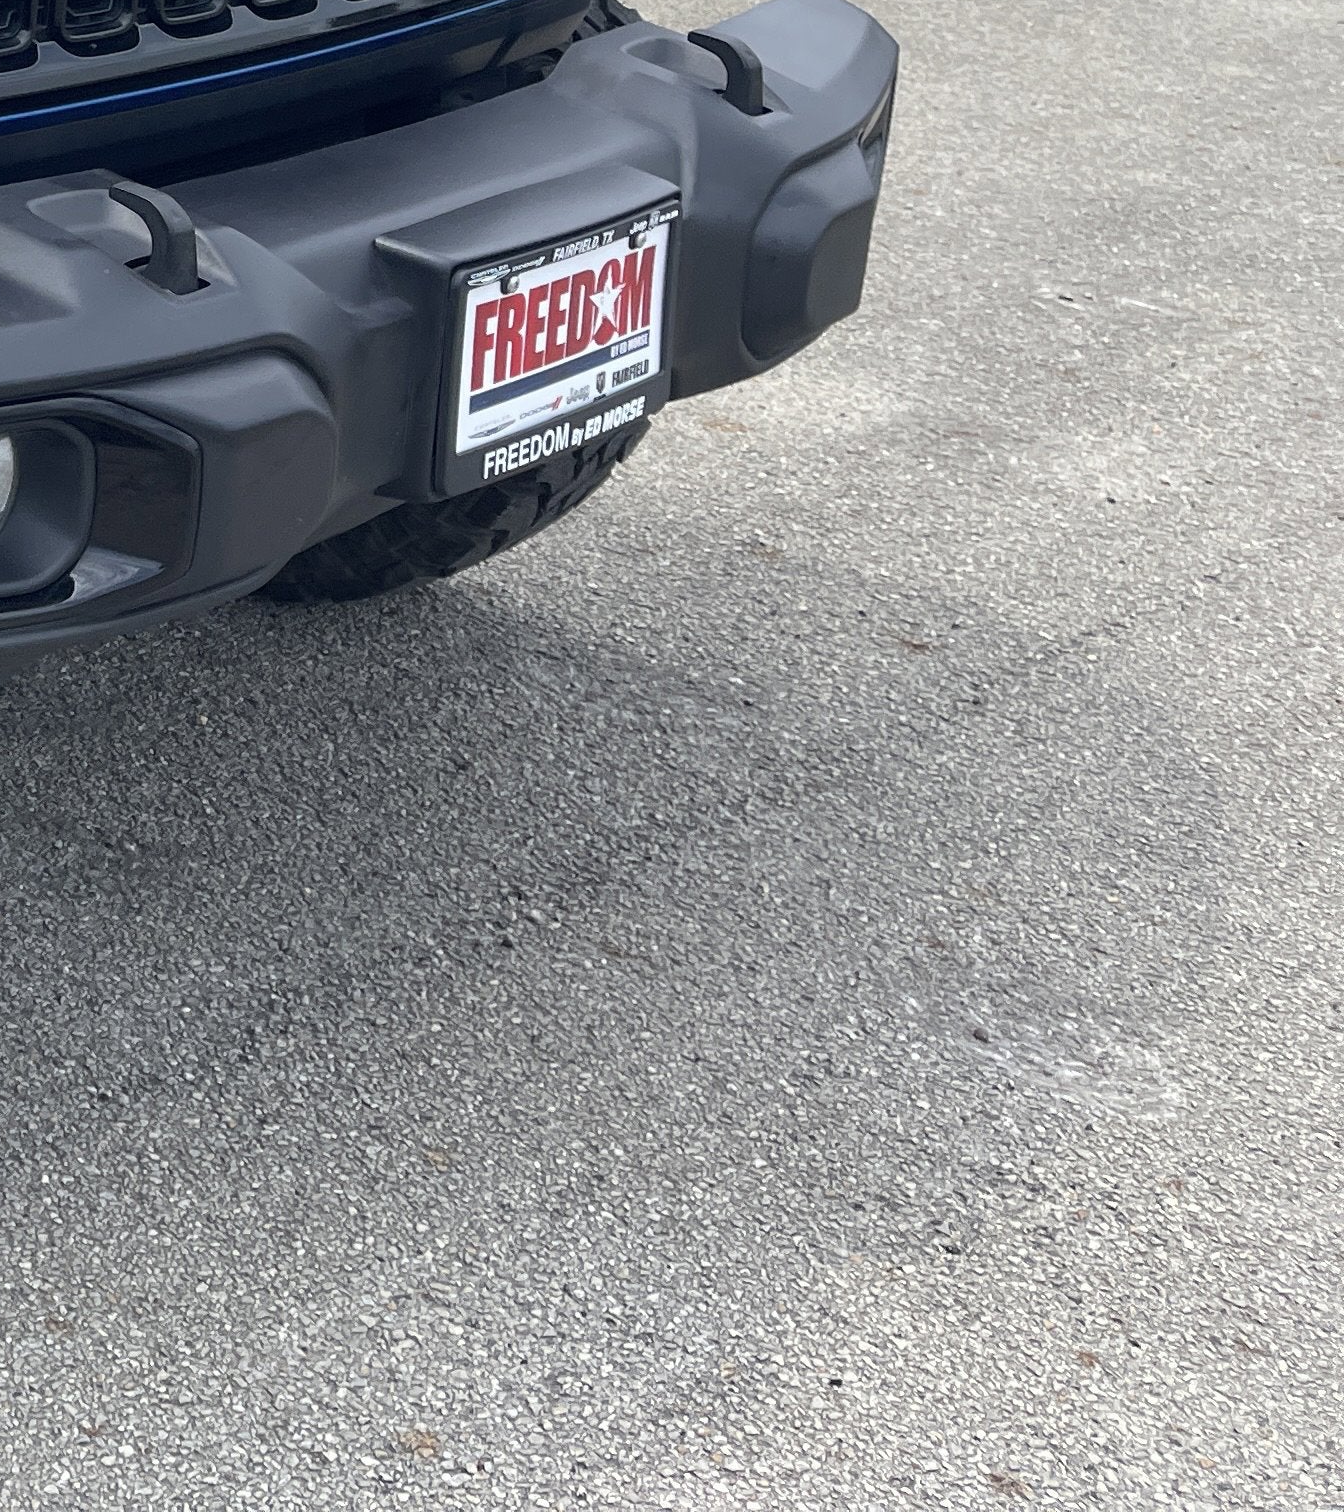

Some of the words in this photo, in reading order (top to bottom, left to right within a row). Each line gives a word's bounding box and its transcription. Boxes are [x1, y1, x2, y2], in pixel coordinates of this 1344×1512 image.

[470, 245, 657, 392] FREEDOM
[483, 422, 570, 480] FREEDOM
[584, 415, 602, 440] ED
[602, 395, 646, 433] MORSE
